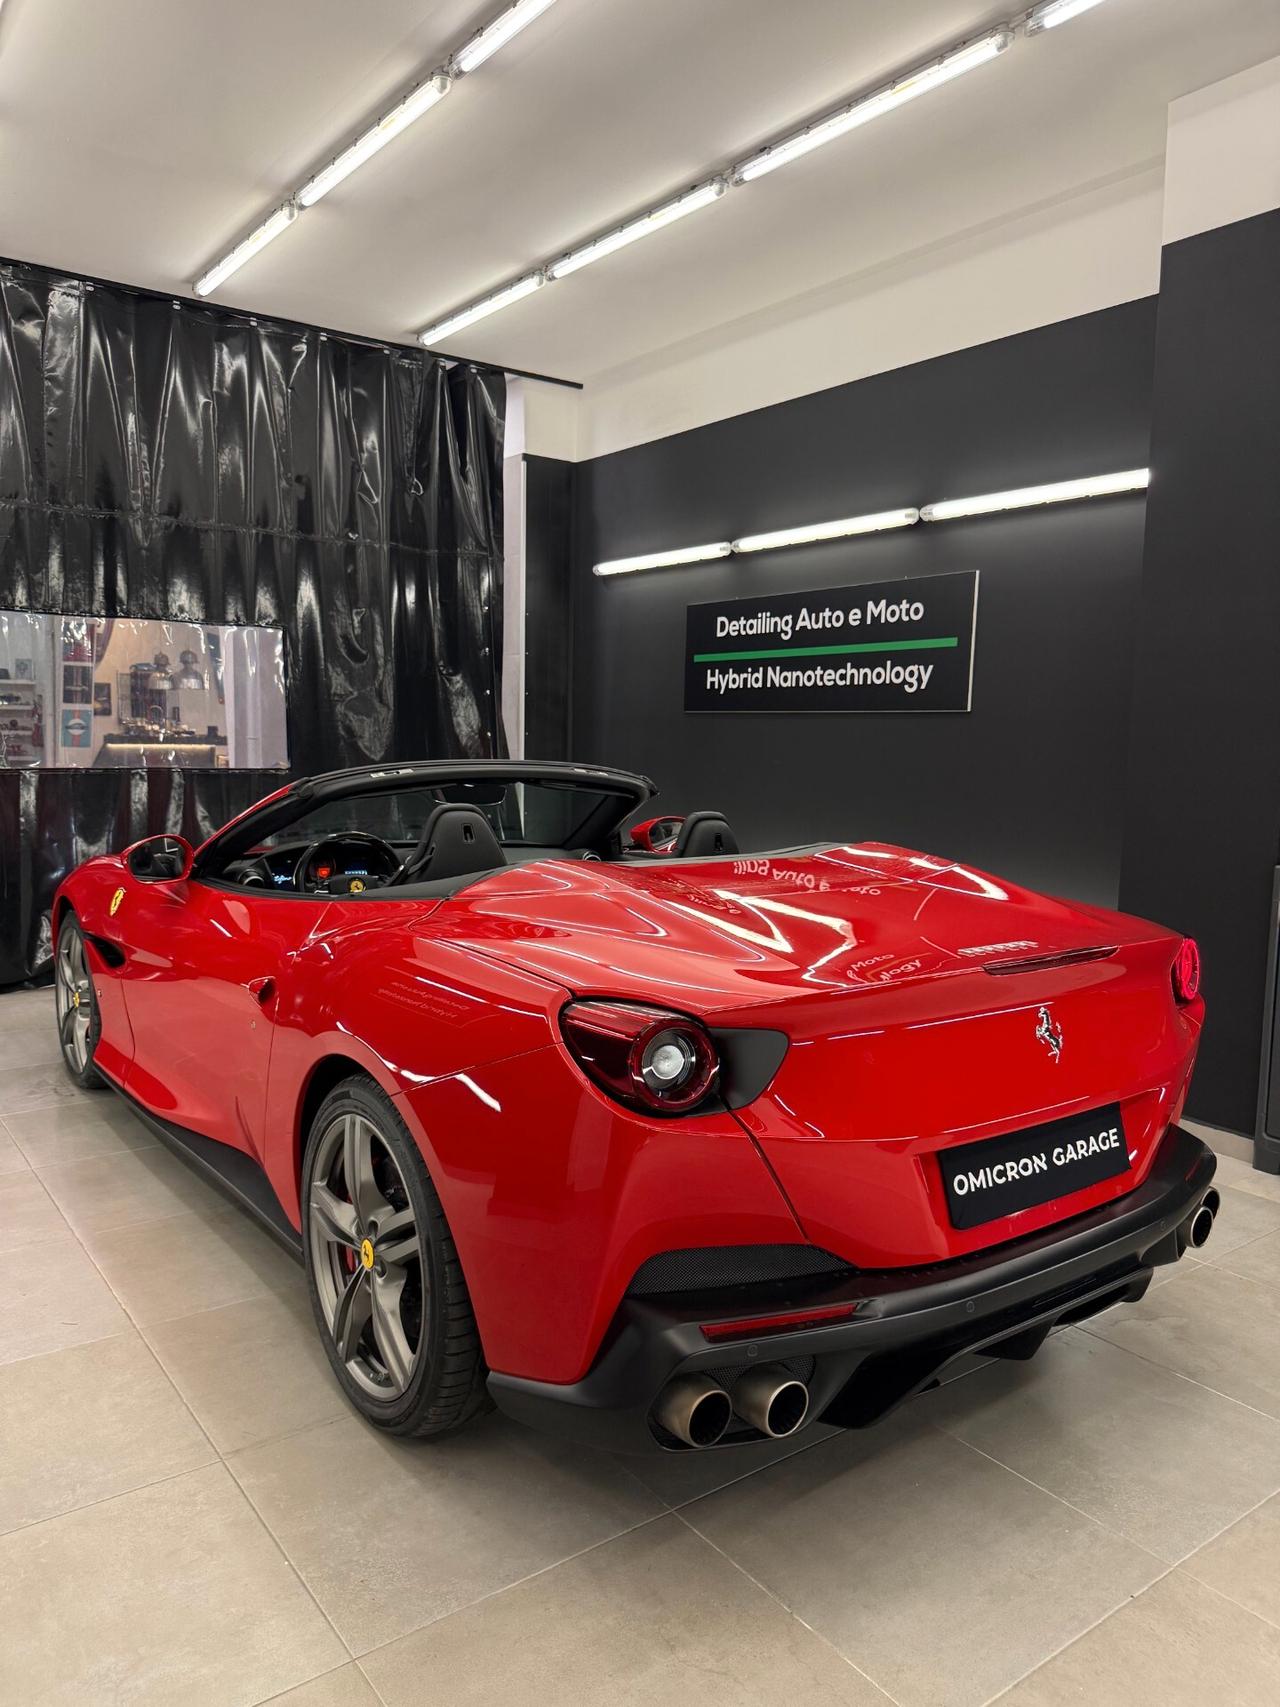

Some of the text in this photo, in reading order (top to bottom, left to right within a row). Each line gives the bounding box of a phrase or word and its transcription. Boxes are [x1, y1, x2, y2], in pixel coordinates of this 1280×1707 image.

[716, 599, 924, 640] Detailing Auto e Moto
[706, 660, 934, 694] Hybrid Nanotechnology
[953, 1128, 1120, 1196] OMICRON GARAGE
